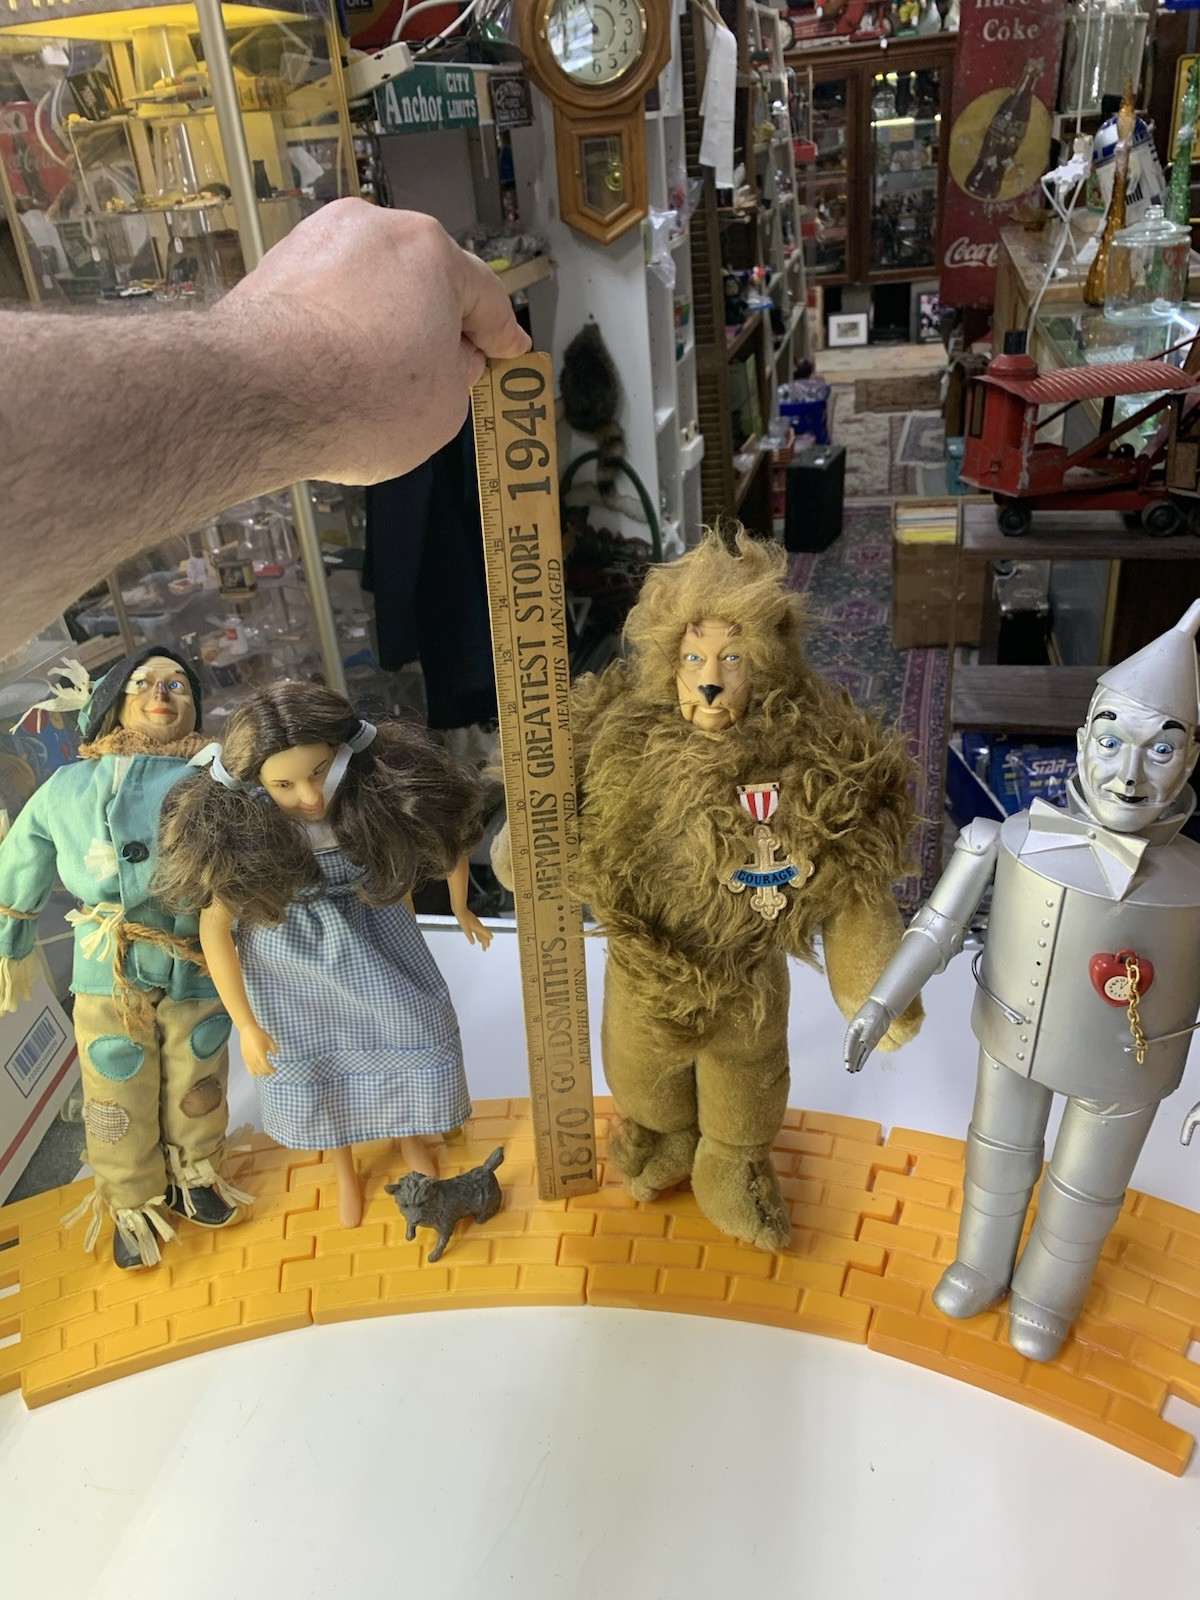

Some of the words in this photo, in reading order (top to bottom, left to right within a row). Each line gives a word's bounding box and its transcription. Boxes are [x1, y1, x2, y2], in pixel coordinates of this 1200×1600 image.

[624, 19, 633, 35] 3
[982, 17, 1039, 42] Coke
[619, 40, 628, 54] 4
[592, 60, 602, 75] 6
[609, 53, 618, 69] 5
[446, 72, 470, 93] CITY
[384, 80, 444, 125] Anchor
[447, 98, 476, 119] LIMITS
[484, 417, 495, 432] 17
[500, 366, 552, 501] 1940
[489, 480, 500, 494] 16
[494, 539, 504, 553] 15
[508, 523, 545, 623] STORE
[498, 594, 508, 608] 14
[547, 558, 565, 649] MANAGED
[503, 649, 512, 663] 13
[553, 656, 571, 732] MEMPHIS
[507, 702, 517, 715] 12
[517, 635, 556, 779] GREATEST
[512, 752, 521, 763] 11
[1028, 759, 1067, 776] STAR
[516, 800, 526, 812] 10
[520, 848, 529, 856] 9
[737, 865, 795, 886] COURAGE
[523, 892, 532, 900] 8
[573, 968, 587, 1002] BORN
[576, 1008, 591, 1067] MEMPHIS
[555, 1107, 593, 1186] 1870
